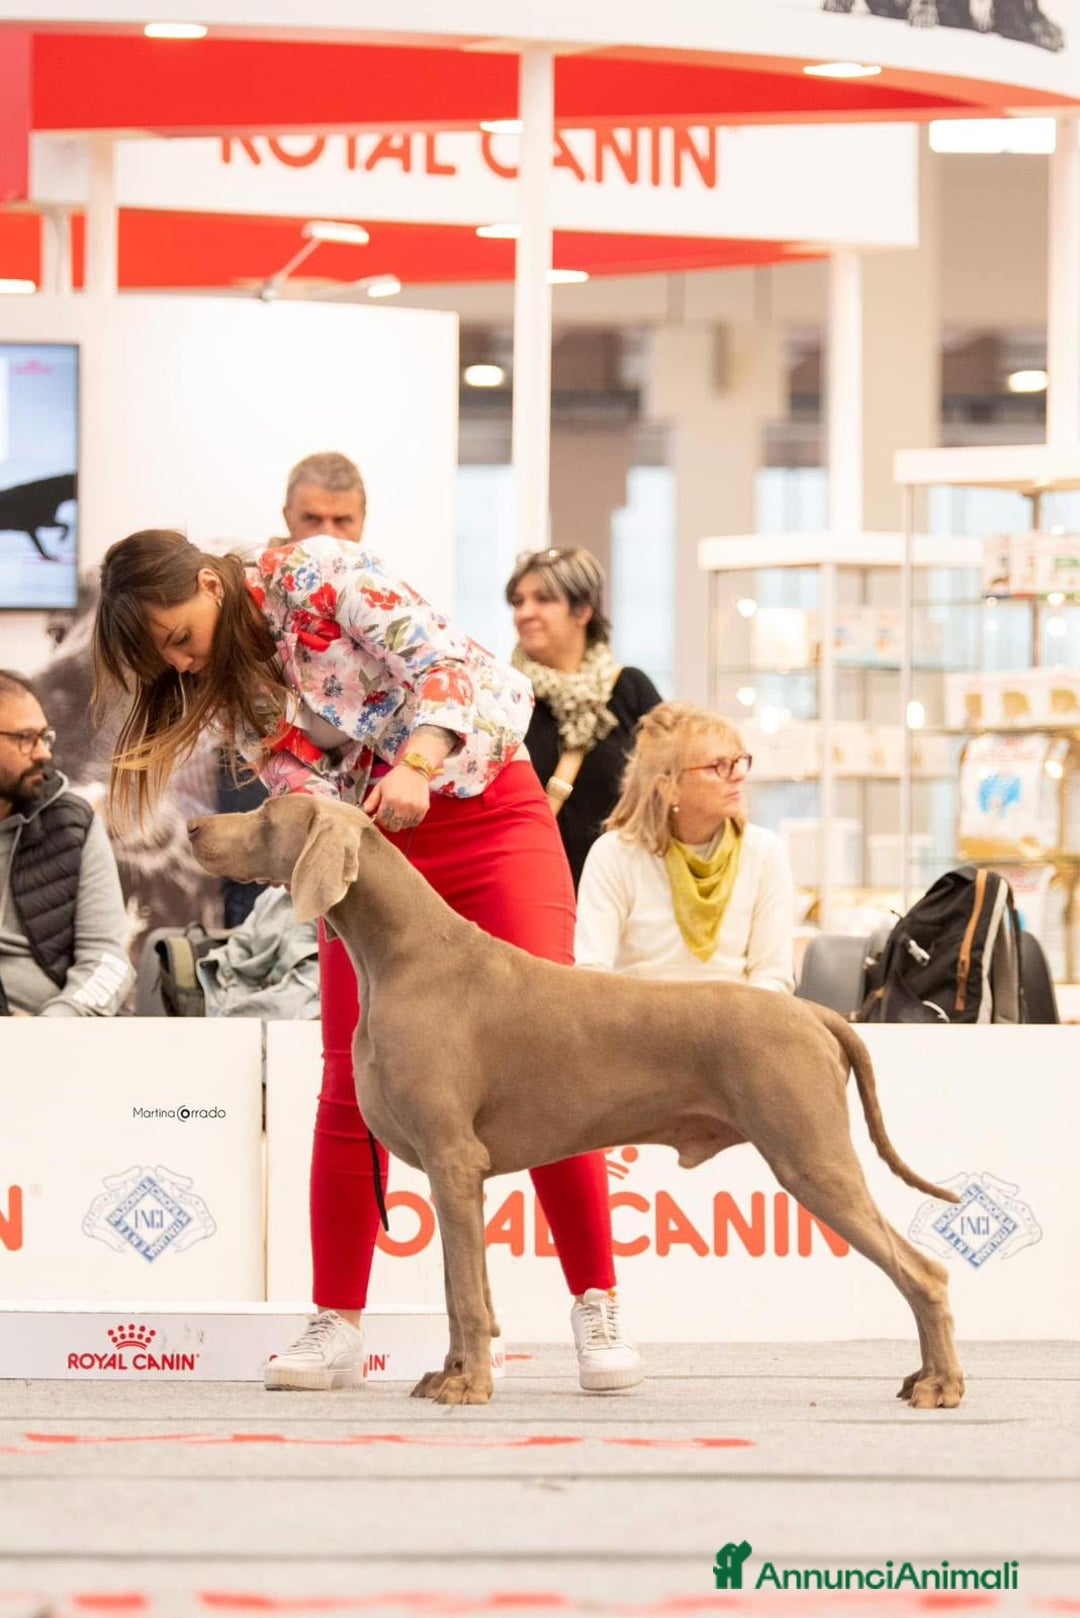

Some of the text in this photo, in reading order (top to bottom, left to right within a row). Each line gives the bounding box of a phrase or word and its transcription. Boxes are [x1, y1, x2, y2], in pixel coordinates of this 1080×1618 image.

[482, 126, 716, 188] CANIN
[375, 1190, 560, 1257] OAL
[67, 1353, 195, 1370] ROYAL CANIN
